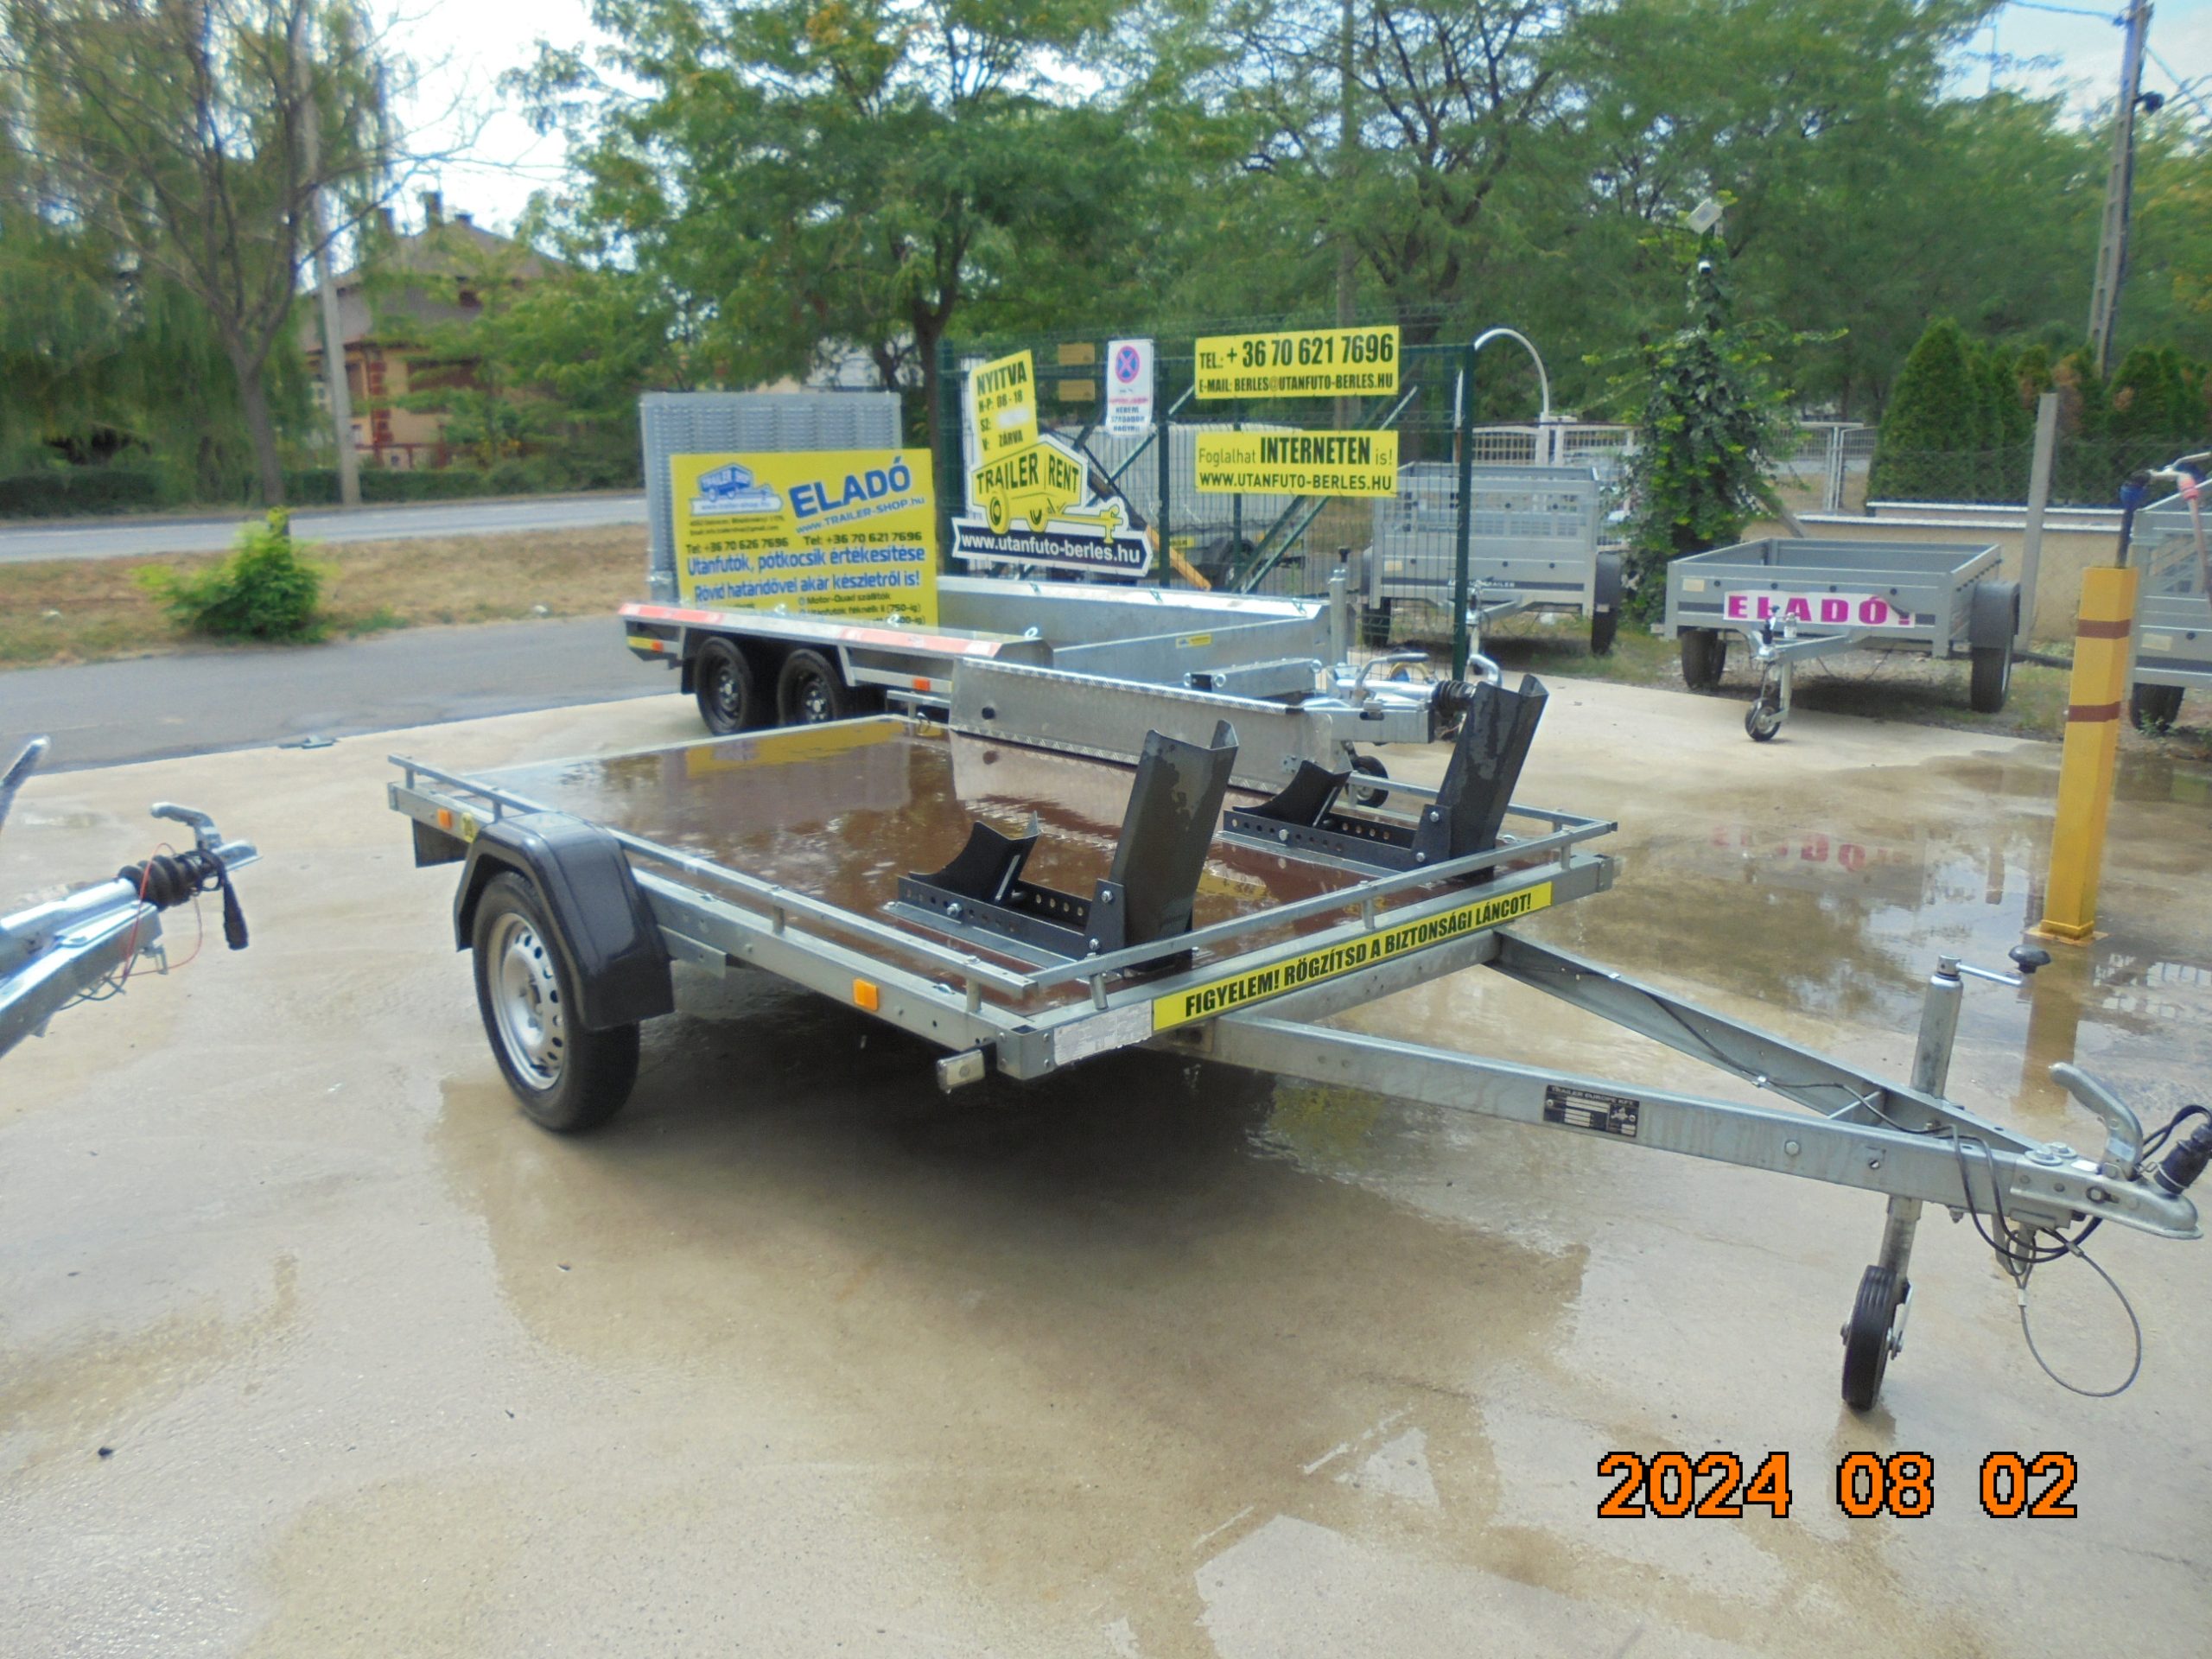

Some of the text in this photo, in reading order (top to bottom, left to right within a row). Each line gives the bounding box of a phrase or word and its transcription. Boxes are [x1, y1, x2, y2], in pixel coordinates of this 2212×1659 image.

[1271, 338, 1293, 366] 70
[1299, 336, 1333, 365] 621
[1341, 334, 1394, 364] 7696
[976, 360, 1027, 397] NYITVA
[1234, 372, 1394, 392] BERLES@UTANFUTO-BERLES.HU
[1198, 436, 1393, 467] Foglalhat INTERNETEN is!
[788, 455, 911, 519] ELADÓ
[976, 451, 1080, 495] TRAILER RENT
[1199, 472, 1392, 491] WWW.UTANFUTO-BERLES.HU
[724, 540, 737, 550] 70
[827, 534, 849, 544] +36
[852, 532, 866, 543] 70
[868, 531, 888, 543] 621
[892, 531, 923, 542] 7696
[961, 533, 1141, 563] www.utanfuto-berles.hu
[904, 569, 920, 586] is!
[1185, 893, 1532, 1018] FIGYELEM! RÖGZÍTSD A BIZTONSÁGI LÁNCOT!
